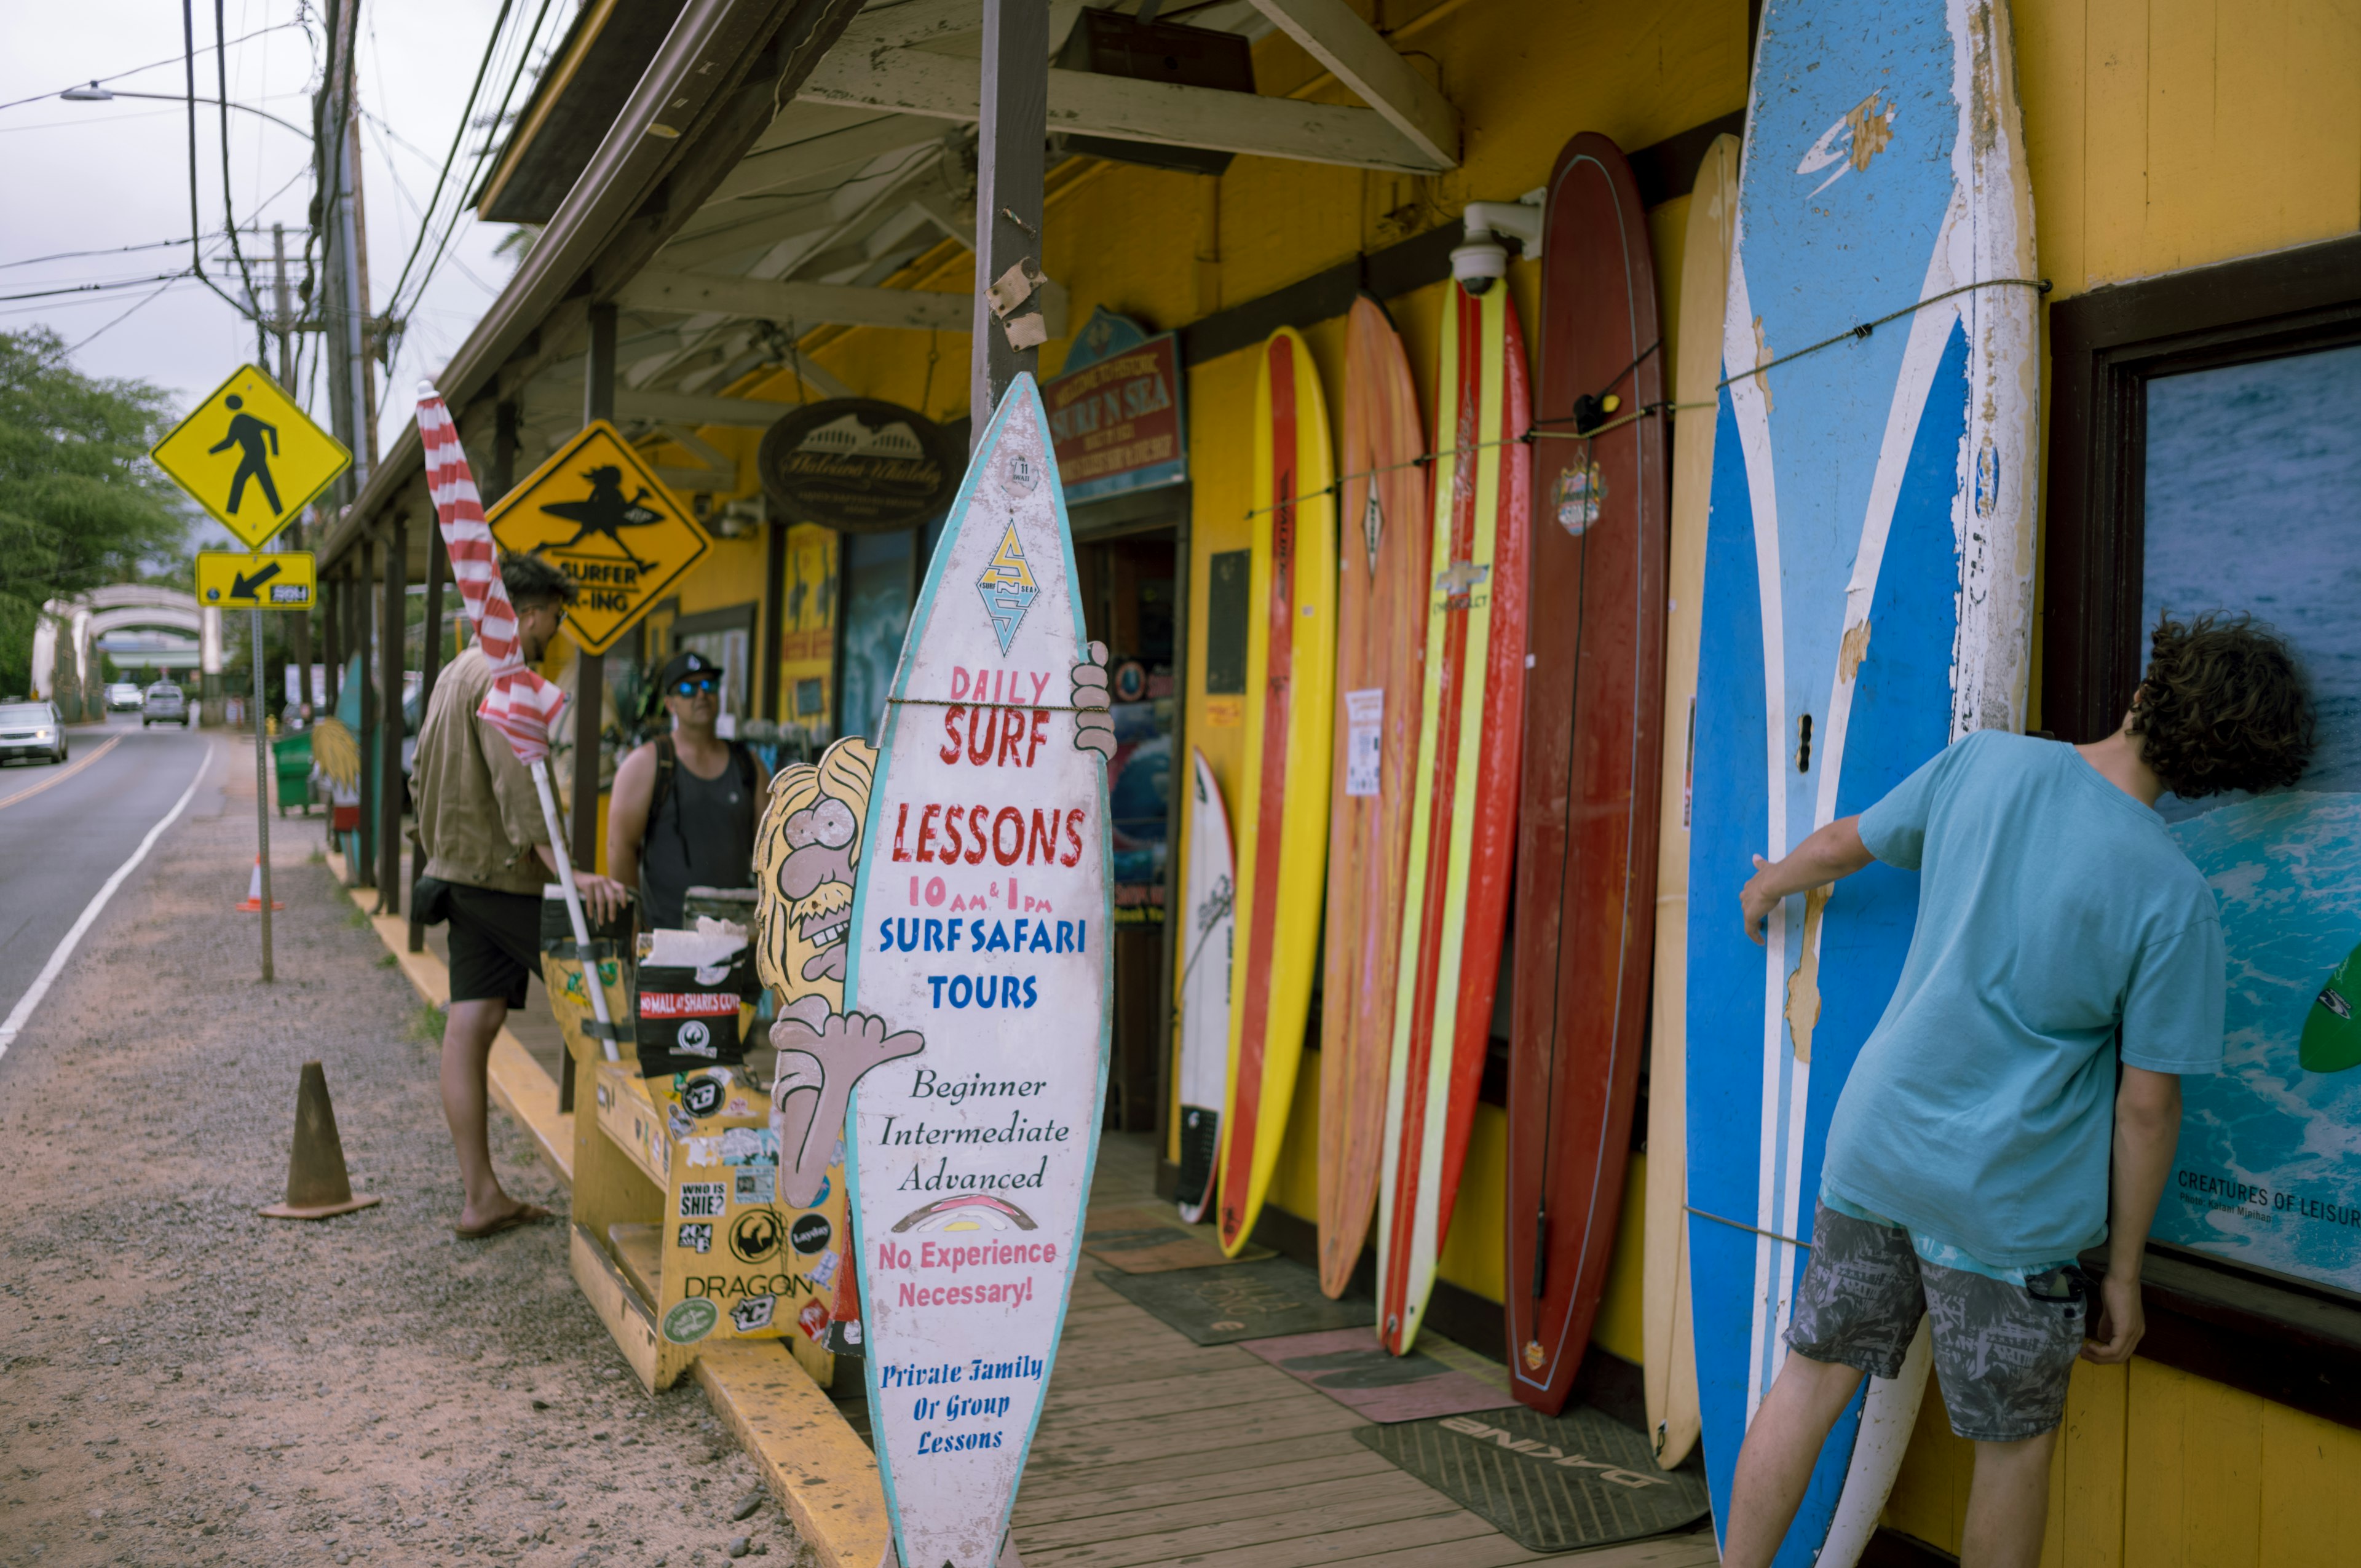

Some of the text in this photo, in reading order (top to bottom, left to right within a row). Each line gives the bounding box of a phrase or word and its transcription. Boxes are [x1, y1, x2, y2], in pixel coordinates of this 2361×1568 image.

[1051, 374, 1171, 447] SURF N SEA
[560, 561, 637, 585] SURFER
[951, 666, 1051, 705] DAILY
[939, 705, 1051, 767] SURF
[892, 803, 1086, 868] LESSONS
[989, 881, 1000, 898] &
[879, 917, 1086, 954] SURF SAFARI
[640, 997, 651, 1012] NO
[651, 992, 676, 1013] MALL
[676, 995, 684, 1010] AT
[684, 992, 719, 1013] SHARKS
[927, 975, 1038, 1009] TOURS
[909, 1069, 1047, 1106] Beginner
[879, 1110, 1070, 1146] Intermediate
[682, 1184, 724, 1194] WHO IS
[896, 1155, 1048, 1191] Advanced
[2178, 1170, 2268, 1206] CREATURES
[2274, 1192, 2295, 1212] OF
[2180, 1192, 2272, 1224] Photo: Kalani Minihan
[879, 1238, 1057, 1273] No Experience
[685, 1274, 813, 1299] DRAGON
[898, 1277, 1033, 1309] Necessary!
[880, 1355, 1044, 1388] Private Family
[913, 1394, 1010, 1421] Or Group
[917, 1430, 1003, 1455] Lessons
[1438, 1416, 1672, 1488] DAKINE
